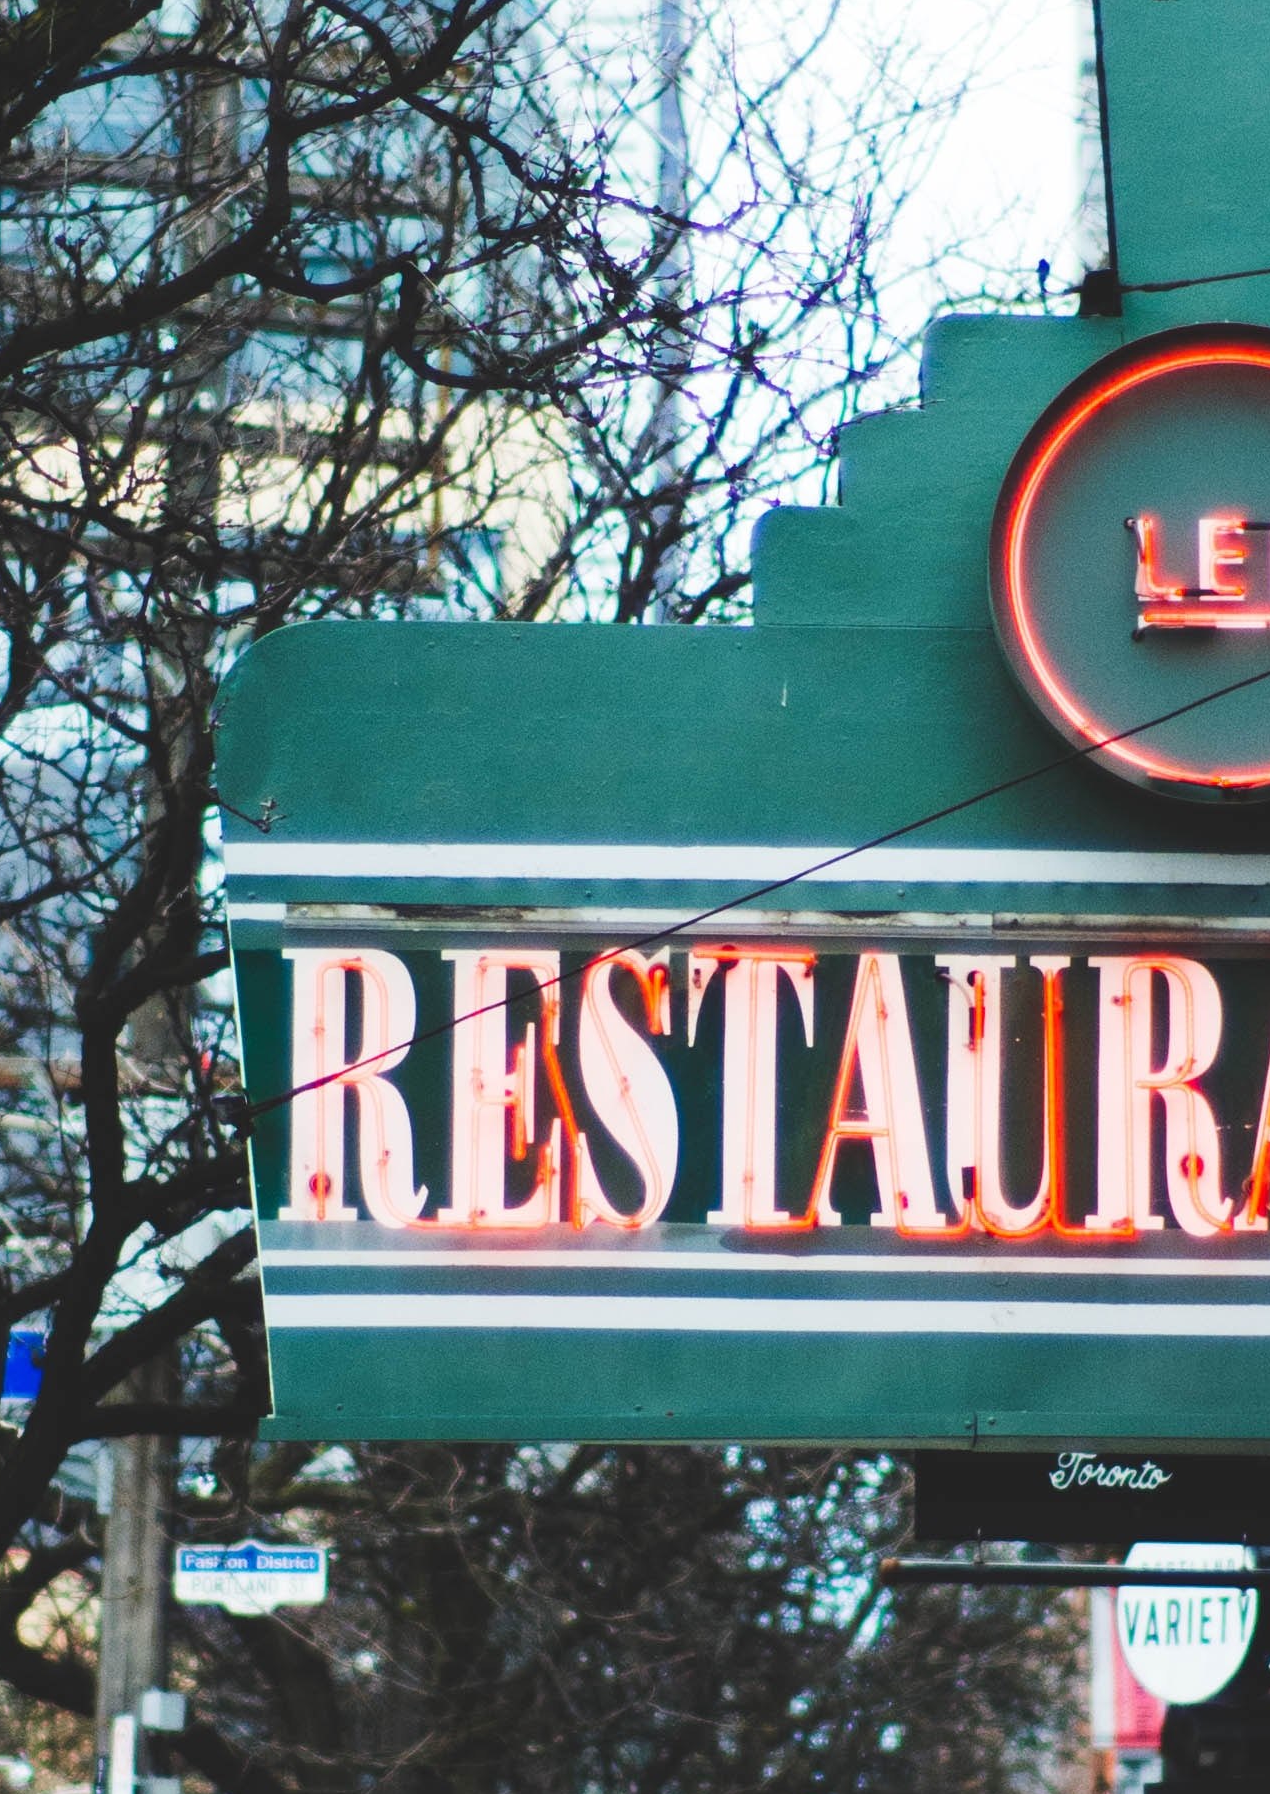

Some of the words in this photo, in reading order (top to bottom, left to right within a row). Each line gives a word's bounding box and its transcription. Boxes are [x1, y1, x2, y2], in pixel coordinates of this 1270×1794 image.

[1049, 1452, 1173, 1490] Toronto
[256, 1554, 316, 1570] District
[1124, 1596, 1251, 1646] VARIETY
